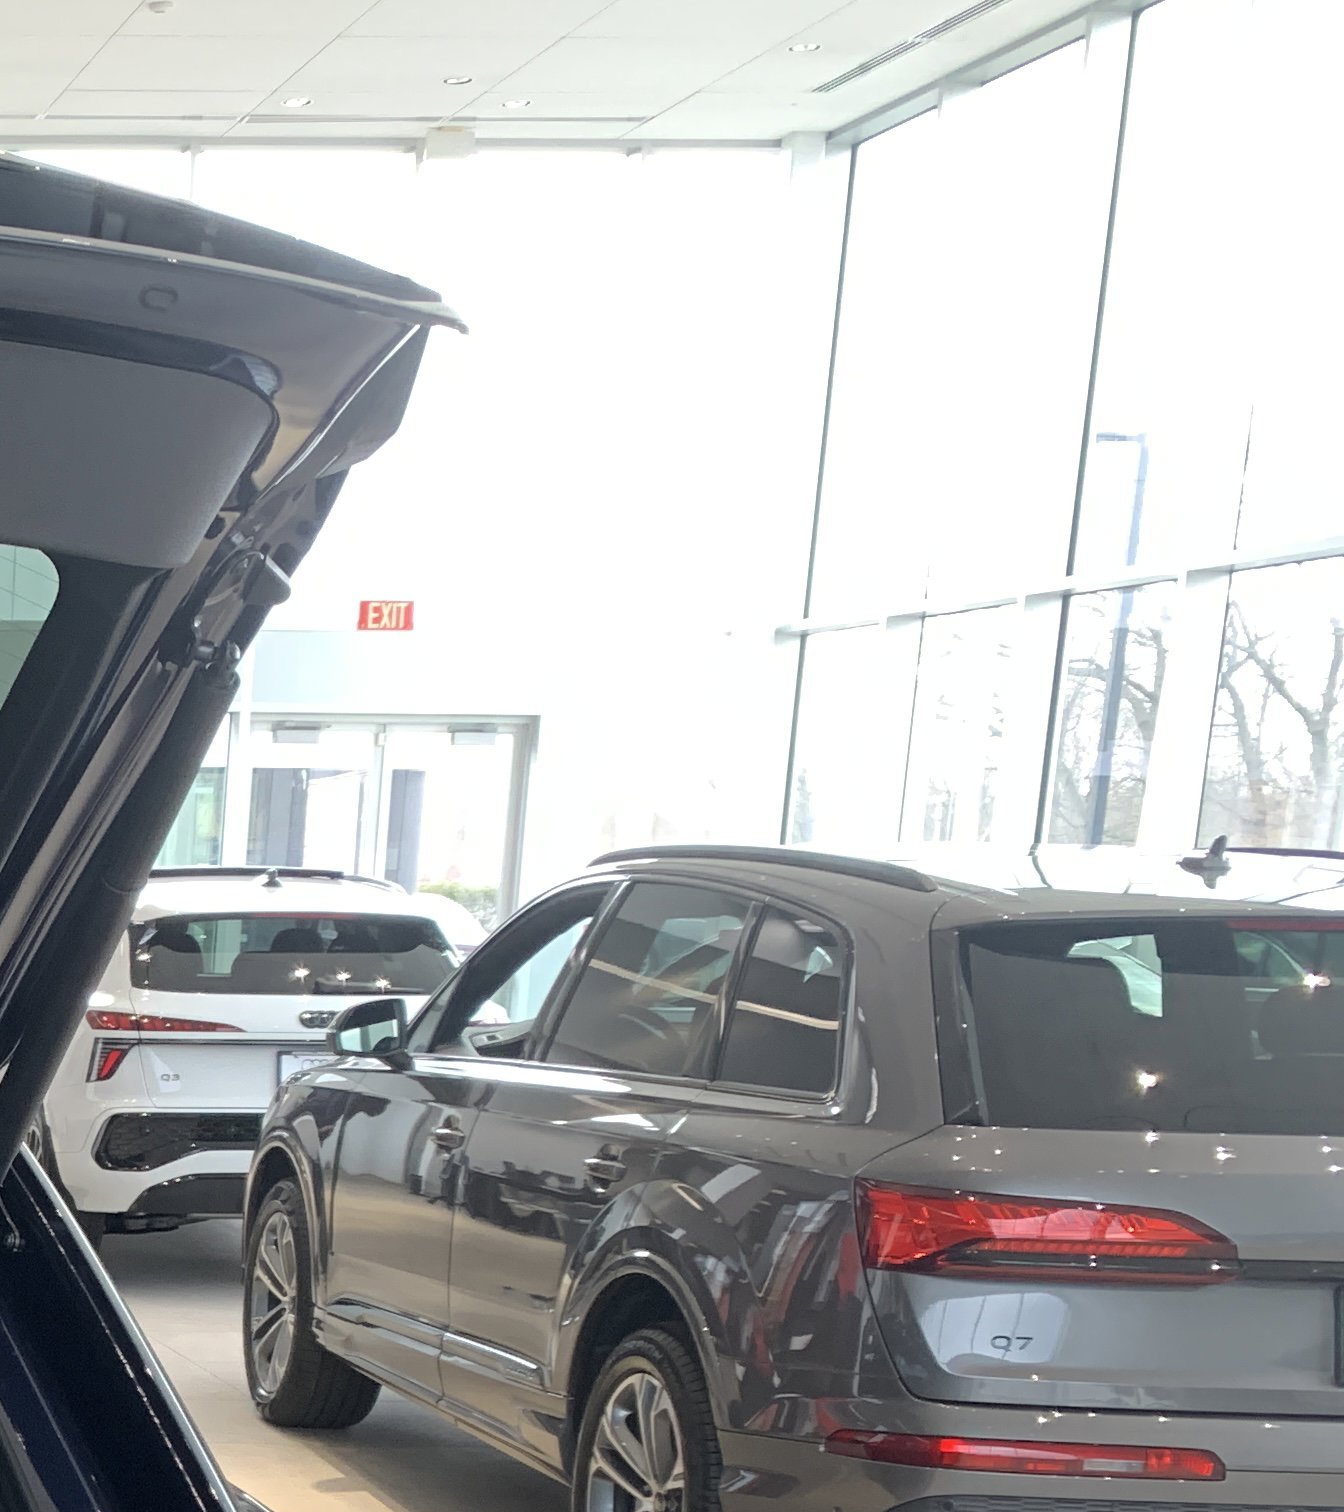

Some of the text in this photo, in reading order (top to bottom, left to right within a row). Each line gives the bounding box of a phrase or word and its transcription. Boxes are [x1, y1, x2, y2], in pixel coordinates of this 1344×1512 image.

[367, 602, 409, 629] EXIT
[161, 1073, 180, 1082] Q3
[991, 1335, 1033, 1352] Q7
